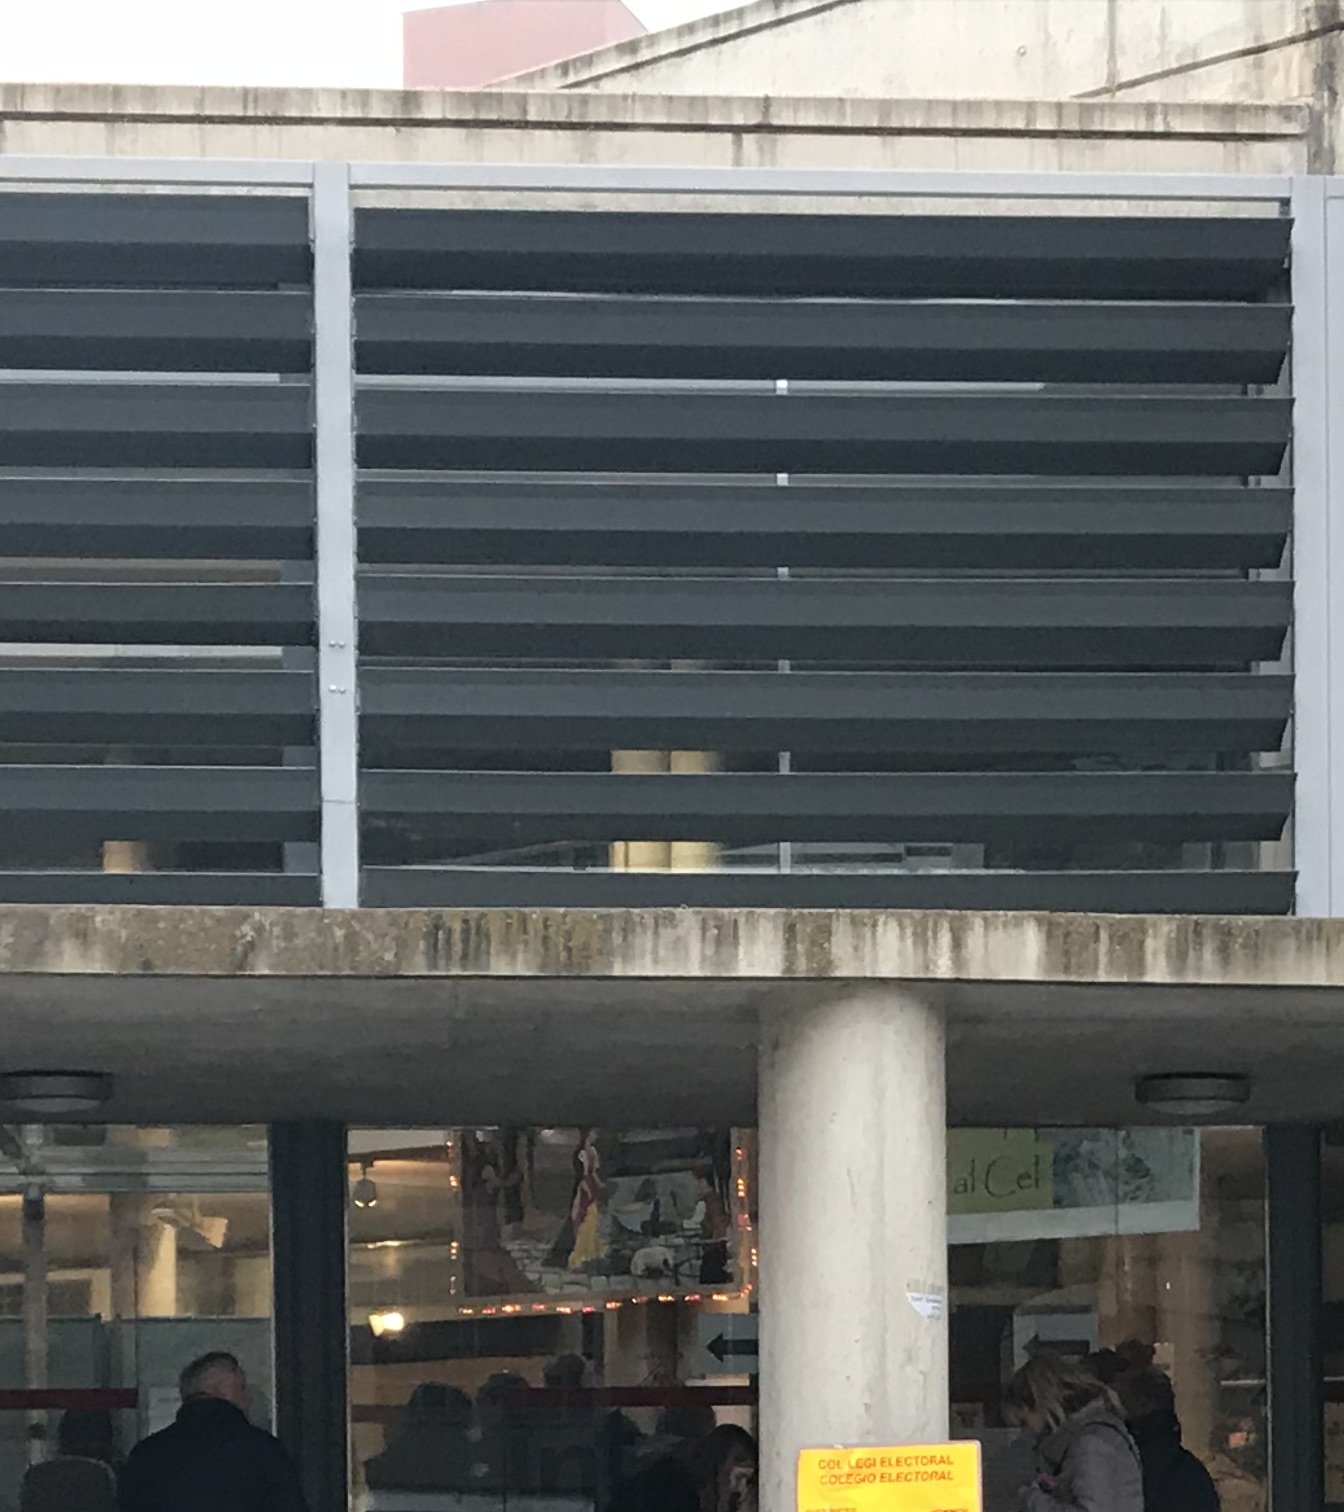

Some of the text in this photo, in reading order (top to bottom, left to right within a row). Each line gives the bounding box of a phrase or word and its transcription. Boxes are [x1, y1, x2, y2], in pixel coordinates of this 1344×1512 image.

[985, 1154, 1040, 1198] Cel
[879, 1455, 954, 1468] ELECTORAL
[820, 1470, 954, 1485] COLEGIO ELECTORAL
